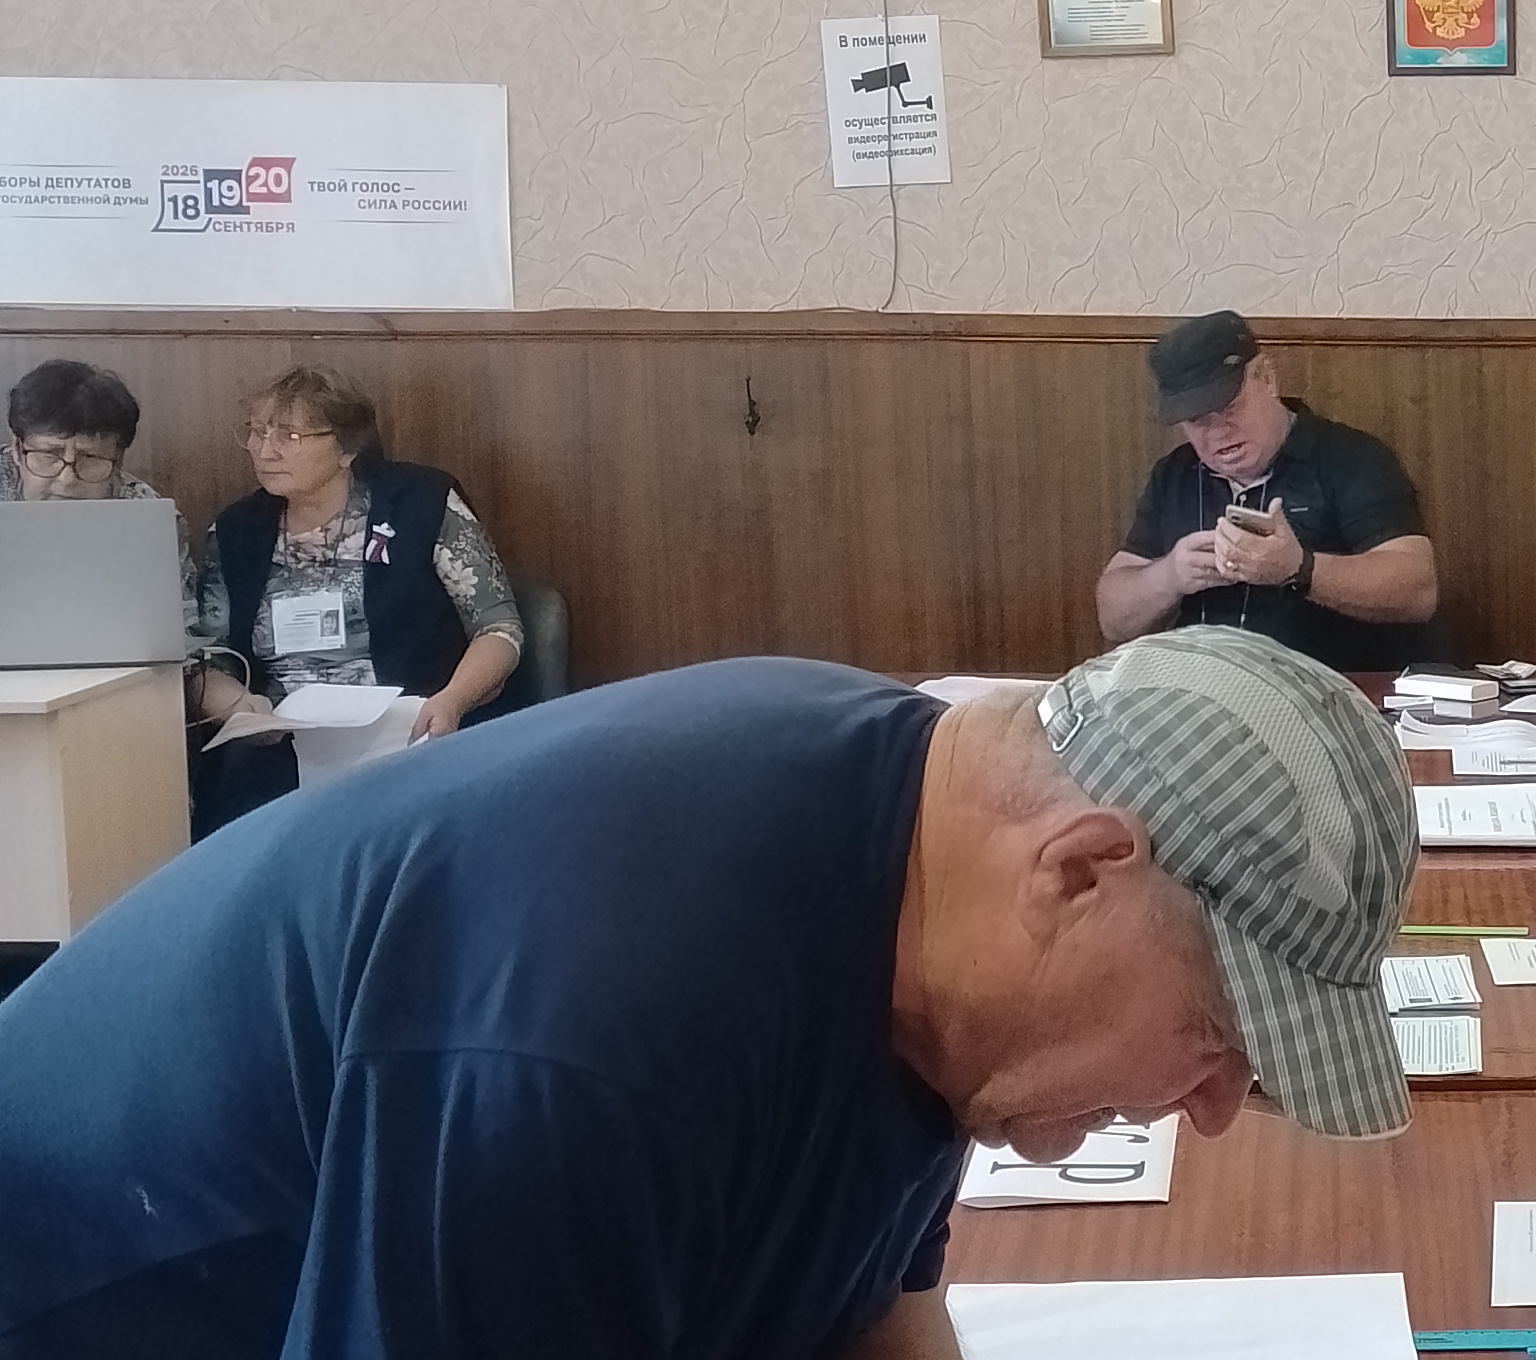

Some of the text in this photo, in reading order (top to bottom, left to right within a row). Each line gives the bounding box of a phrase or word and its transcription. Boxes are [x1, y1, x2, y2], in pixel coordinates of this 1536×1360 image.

[839, 35, 848, 47] В
[160, 164, 199, 176] 2026
[44, 177, 132, 190] ДЕПУТАТОВ
[308, 179, 347, 193] ТВОЙ
[352, 182, 400, 193] ГОЛОС
[167, 166, 289, 220] 18 19 20
[113, 196, 149, 206] ДУМЫ
[357, 198, 467, 211] СИЛА РОССИИ!
[212, 220, 295, 233] СЕНТЯБРЯ
